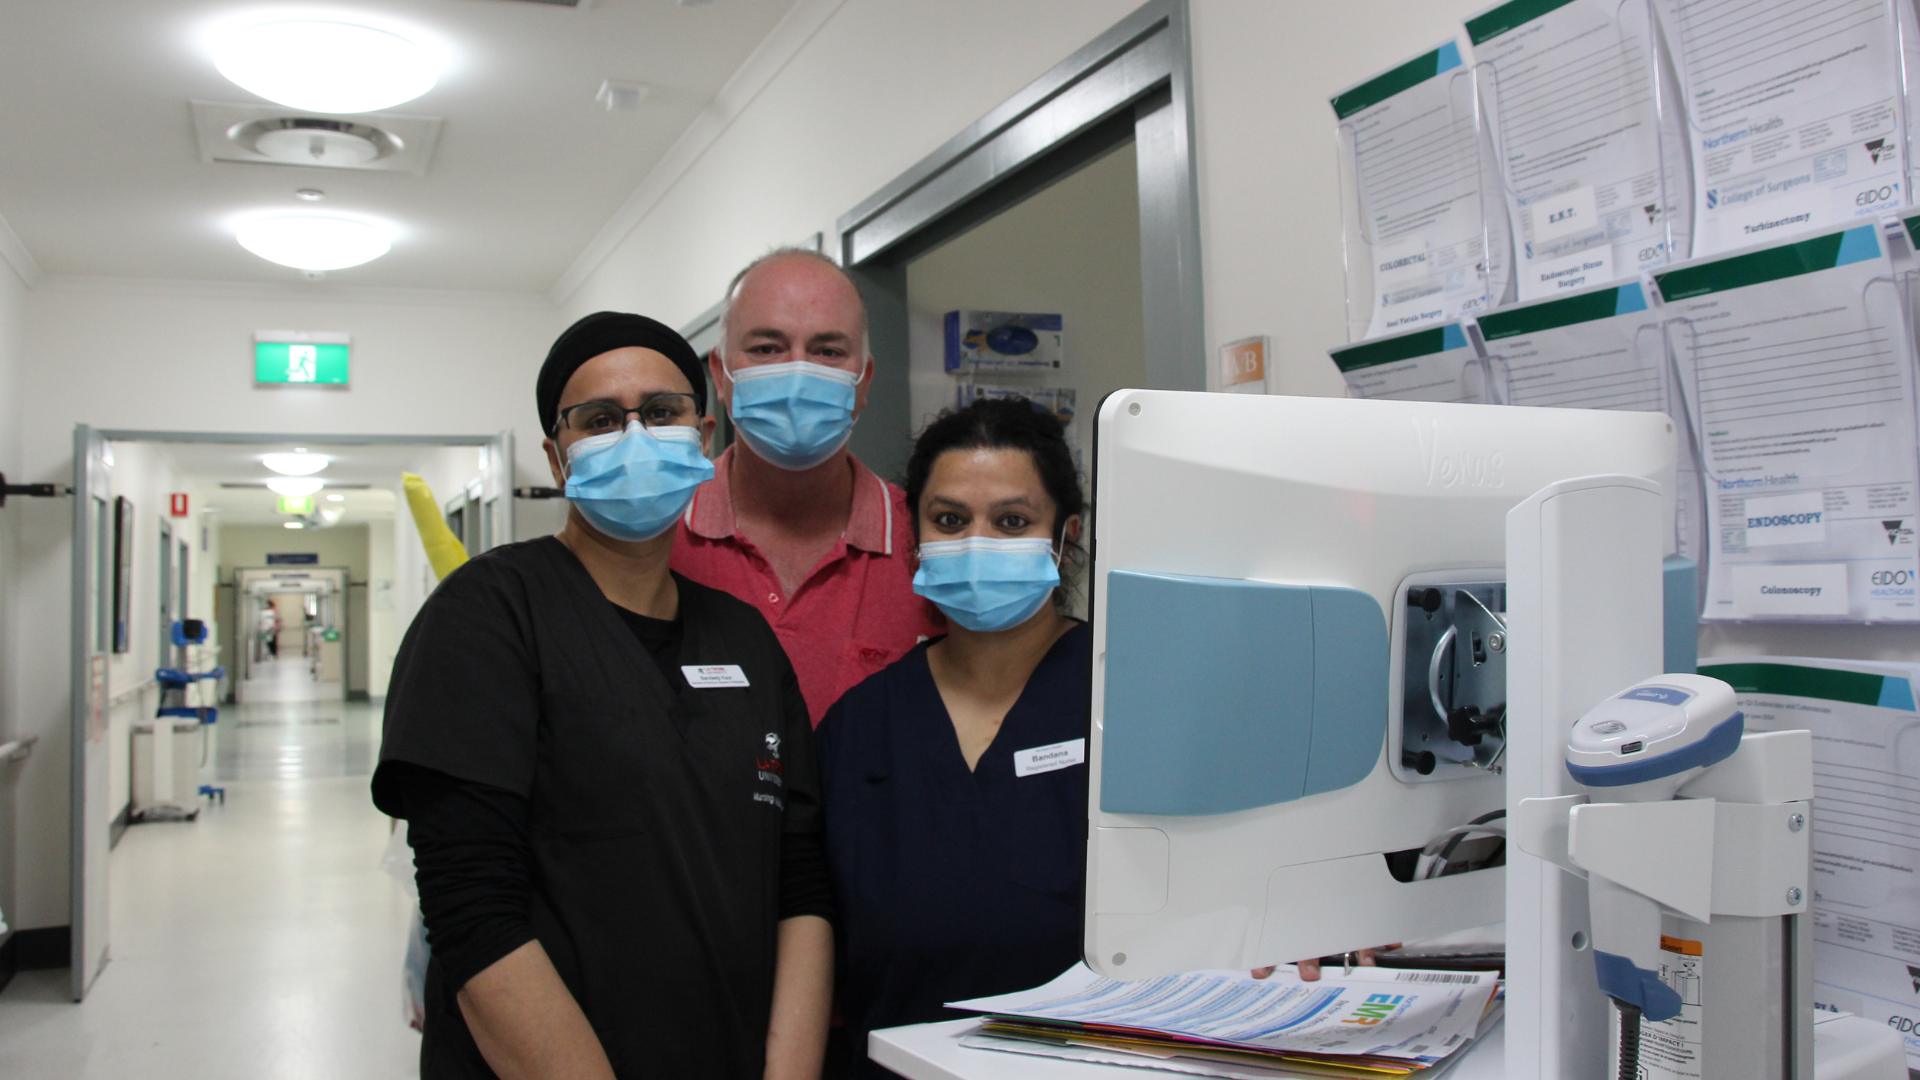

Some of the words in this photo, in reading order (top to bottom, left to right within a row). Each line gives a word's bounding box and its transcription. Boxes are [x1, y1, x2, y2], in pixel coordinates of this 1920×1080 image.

[1703, 129, 1749, 150] Northern
[1750, 116, 1784, 136] Health
[1721, 189, 1754, 206] College
[1767, 173, 1811, 194] Surgeons
[1856, 185, 1892, 207] EIDO
[1744, 212, 1811, 234] Turbinectomy
[1380, 253, 1427, 272] COLORECTAL
[1541, 265, 1580, 282] Endoscopic
[1583, 259, 1604, 271] Sinus
[1558, 275, 1586, 288] Surgery
[1420, 309, 1443, 321] Surgery
[1410, 415, 1505, 488] Venus
[1747, 512, 1822, 528] ENDOSCOPY
[1871, 571, 1907, 586] EIDO
[1760, 585, 1822, 596] Colonoscopy
[1032, 750, 1068, 762] Bandana
[1026, 761, 1057, 772] Registered
[1341, 994, 1405, 1026] EMR
